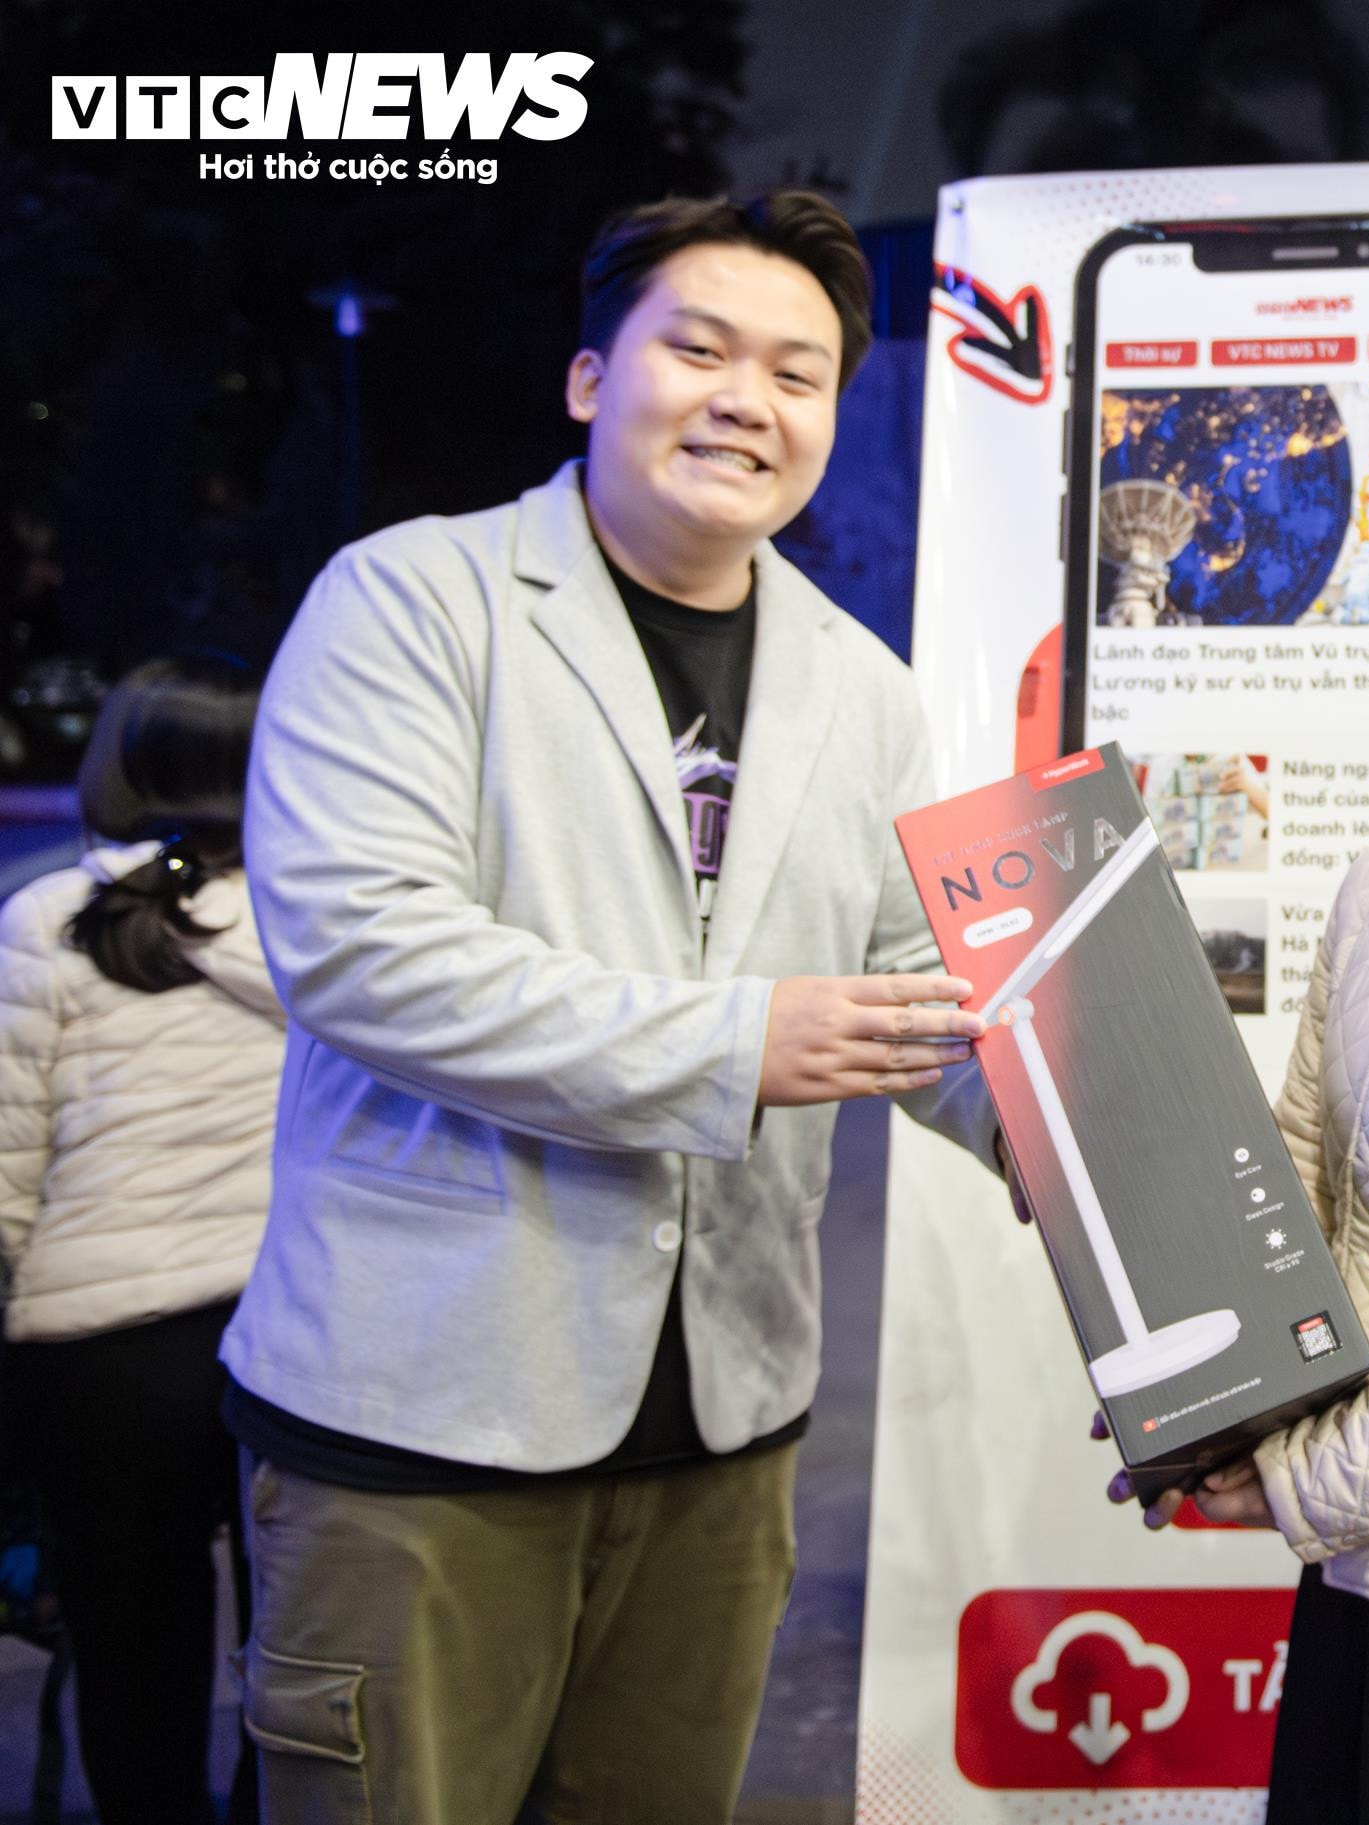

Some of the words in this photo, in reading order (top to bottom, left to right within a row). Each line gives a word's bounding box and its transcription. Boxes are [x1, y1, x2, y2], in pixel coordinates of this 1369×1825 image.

[1227, 344, 1262, 361] VTC
[1263, 343, 1314, 360] NEWS
[1316, 341, 1339, 358] TV
[1094, 643, 1144, 661] Lãnh
[1152, 643, 1190, 663] đạo
[1199, 643, 1256, 664] Trung
[1265, 643, 1304, 660] tâm
[1312, 642, 1337, 659] Vũ
[1093, 674, 1165, 693] Lương
[1174, 672, 1198, 694] kỹ
[1206, 675, 1233, 690] sư
[1242, 673, 1266, 690] vũ
[1273, 675, 1302, 694] trụ
[1310, 669, 1346, 690] vẫn
[1092, 704, 1129, 724] bậc
[1283, 761, 1336, 780] Nâng
[1283, 788, 1329, 807] thuế
[1282, 820, 1346, 836] doanh
[940, 816, 1127, 912] NOVA
[1281, 902, 1324, 921] Vừa
[1281, 934, 1309, 951] Hà
[1234, 1167, 1248, 1180] Eye
